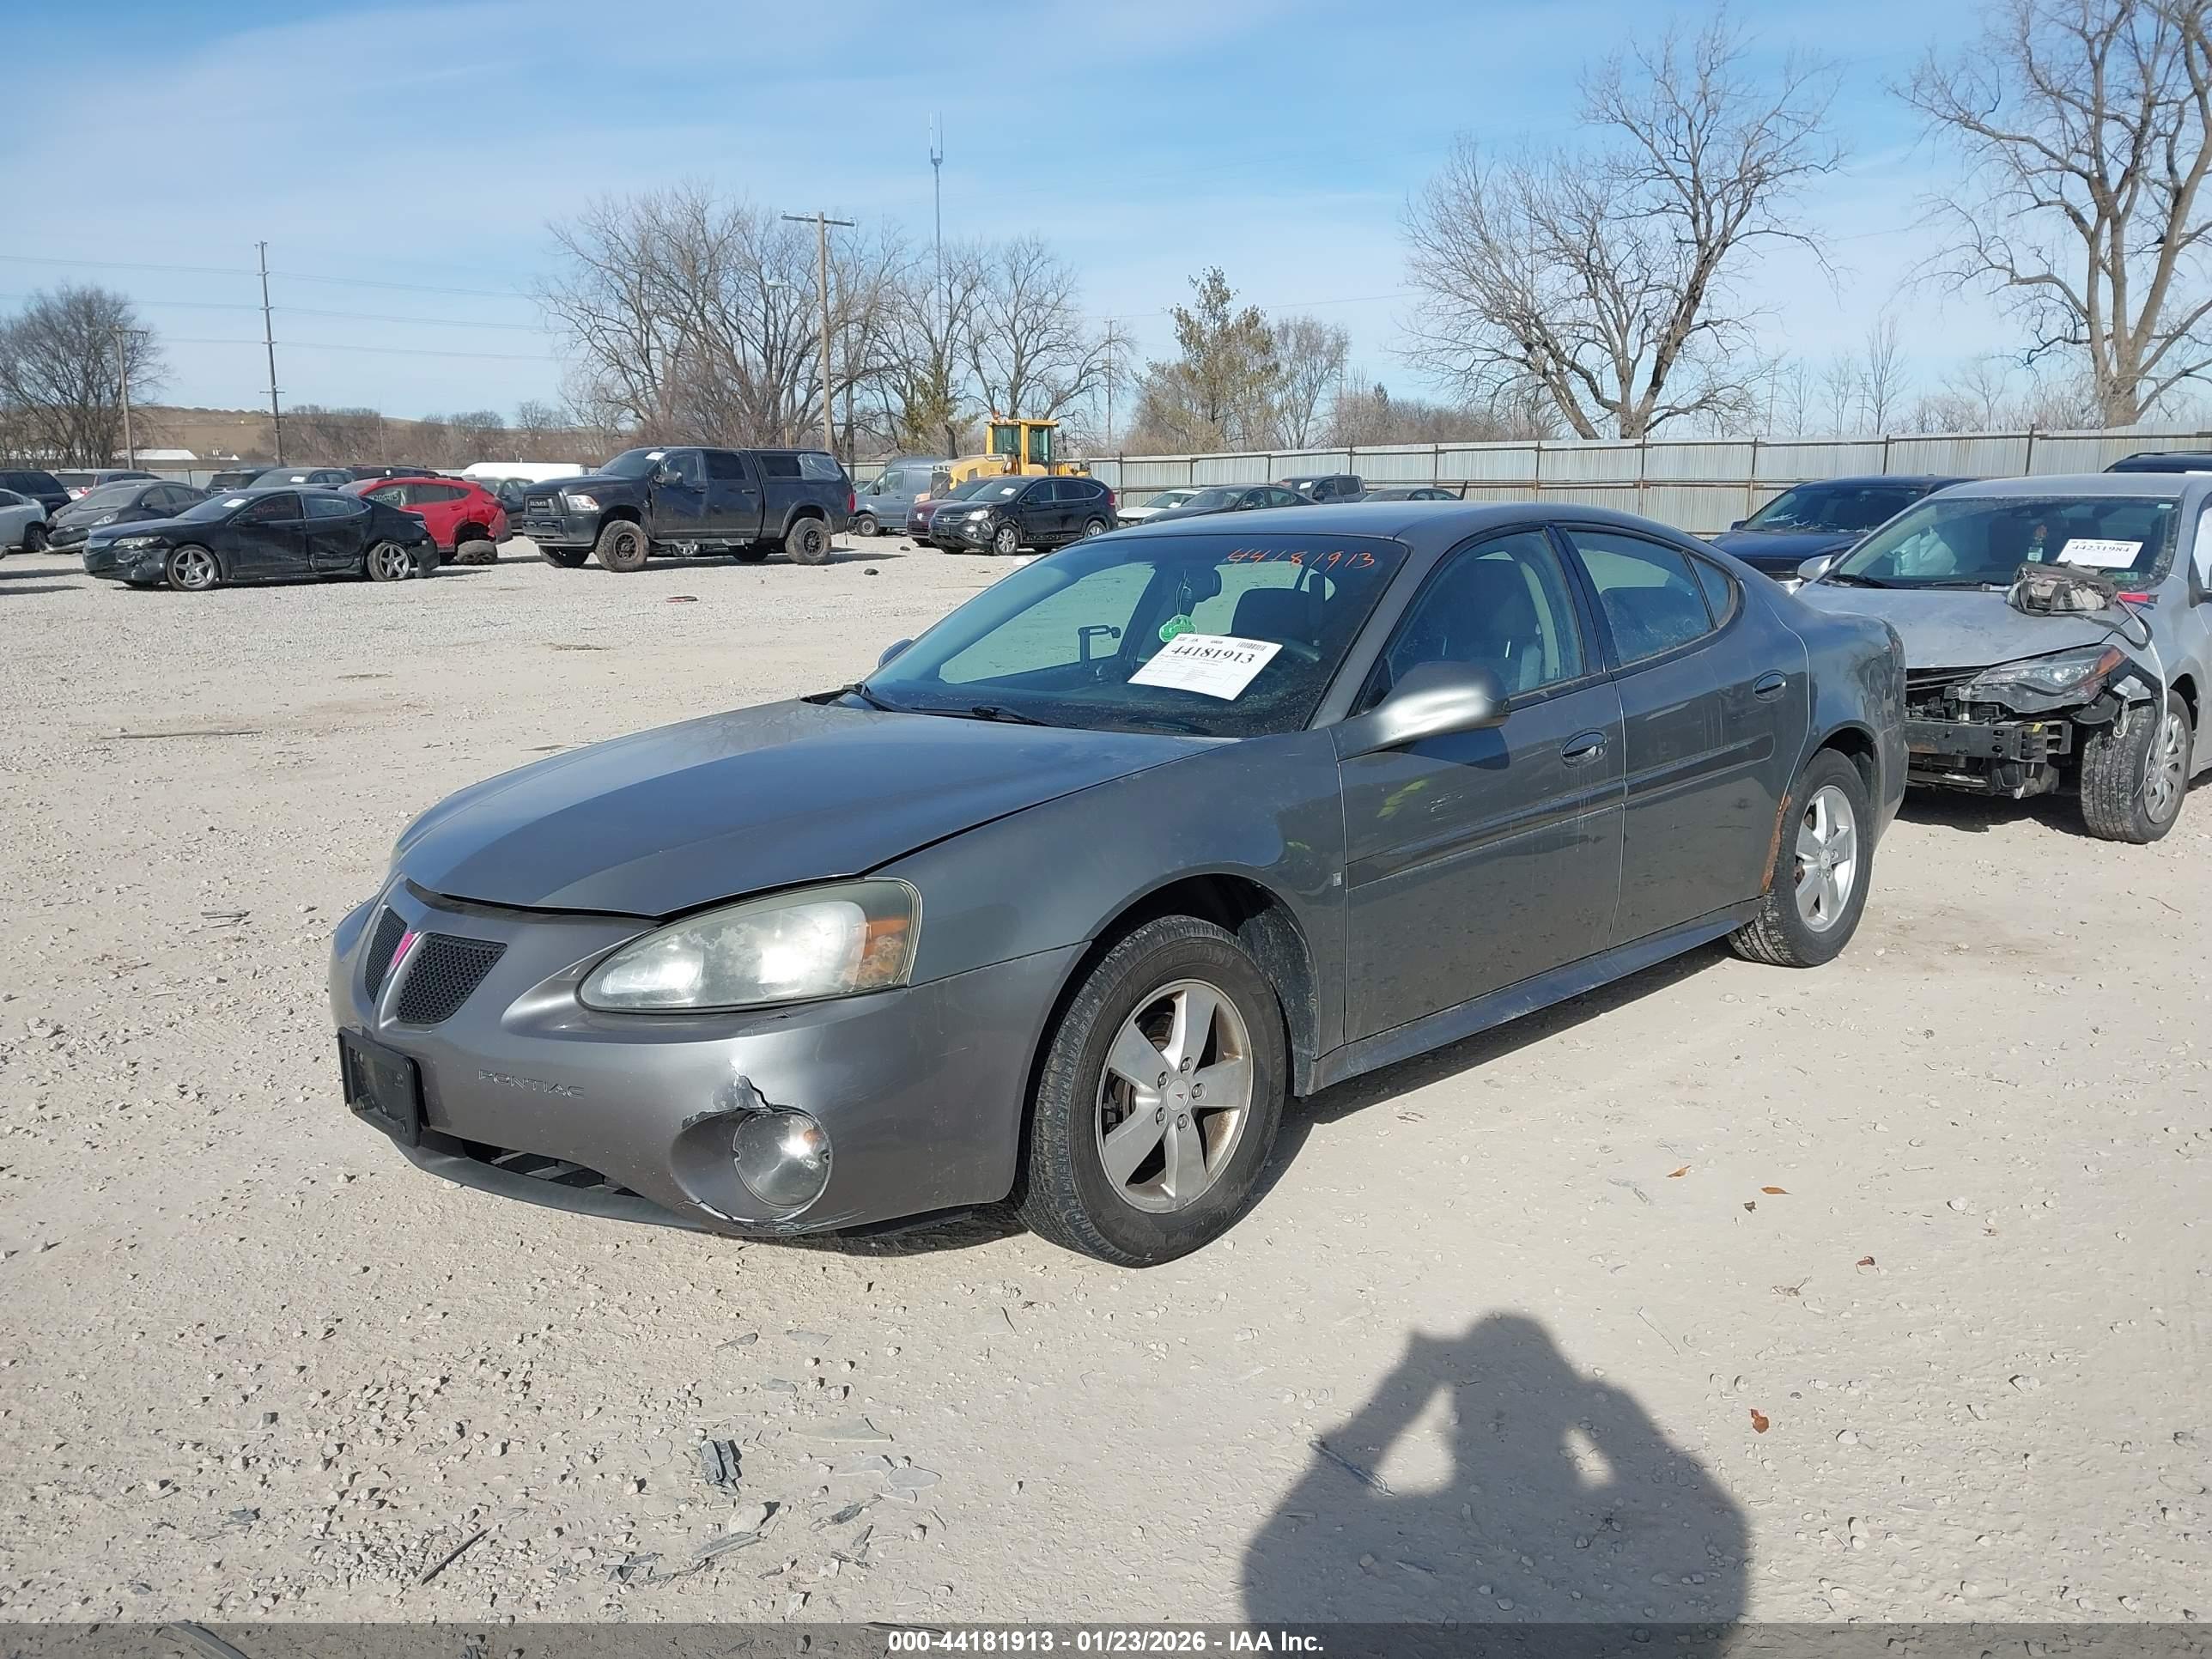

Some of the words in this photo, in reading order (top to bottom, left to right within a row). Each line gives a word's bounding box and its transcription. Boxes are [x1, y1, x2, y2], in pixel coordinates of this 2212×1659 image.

[1226, 548, 1375, 571] 44181913
[1171, 645, 1255, 664] 44181913
[478, 1069, 585, 1099] PONTIAC
